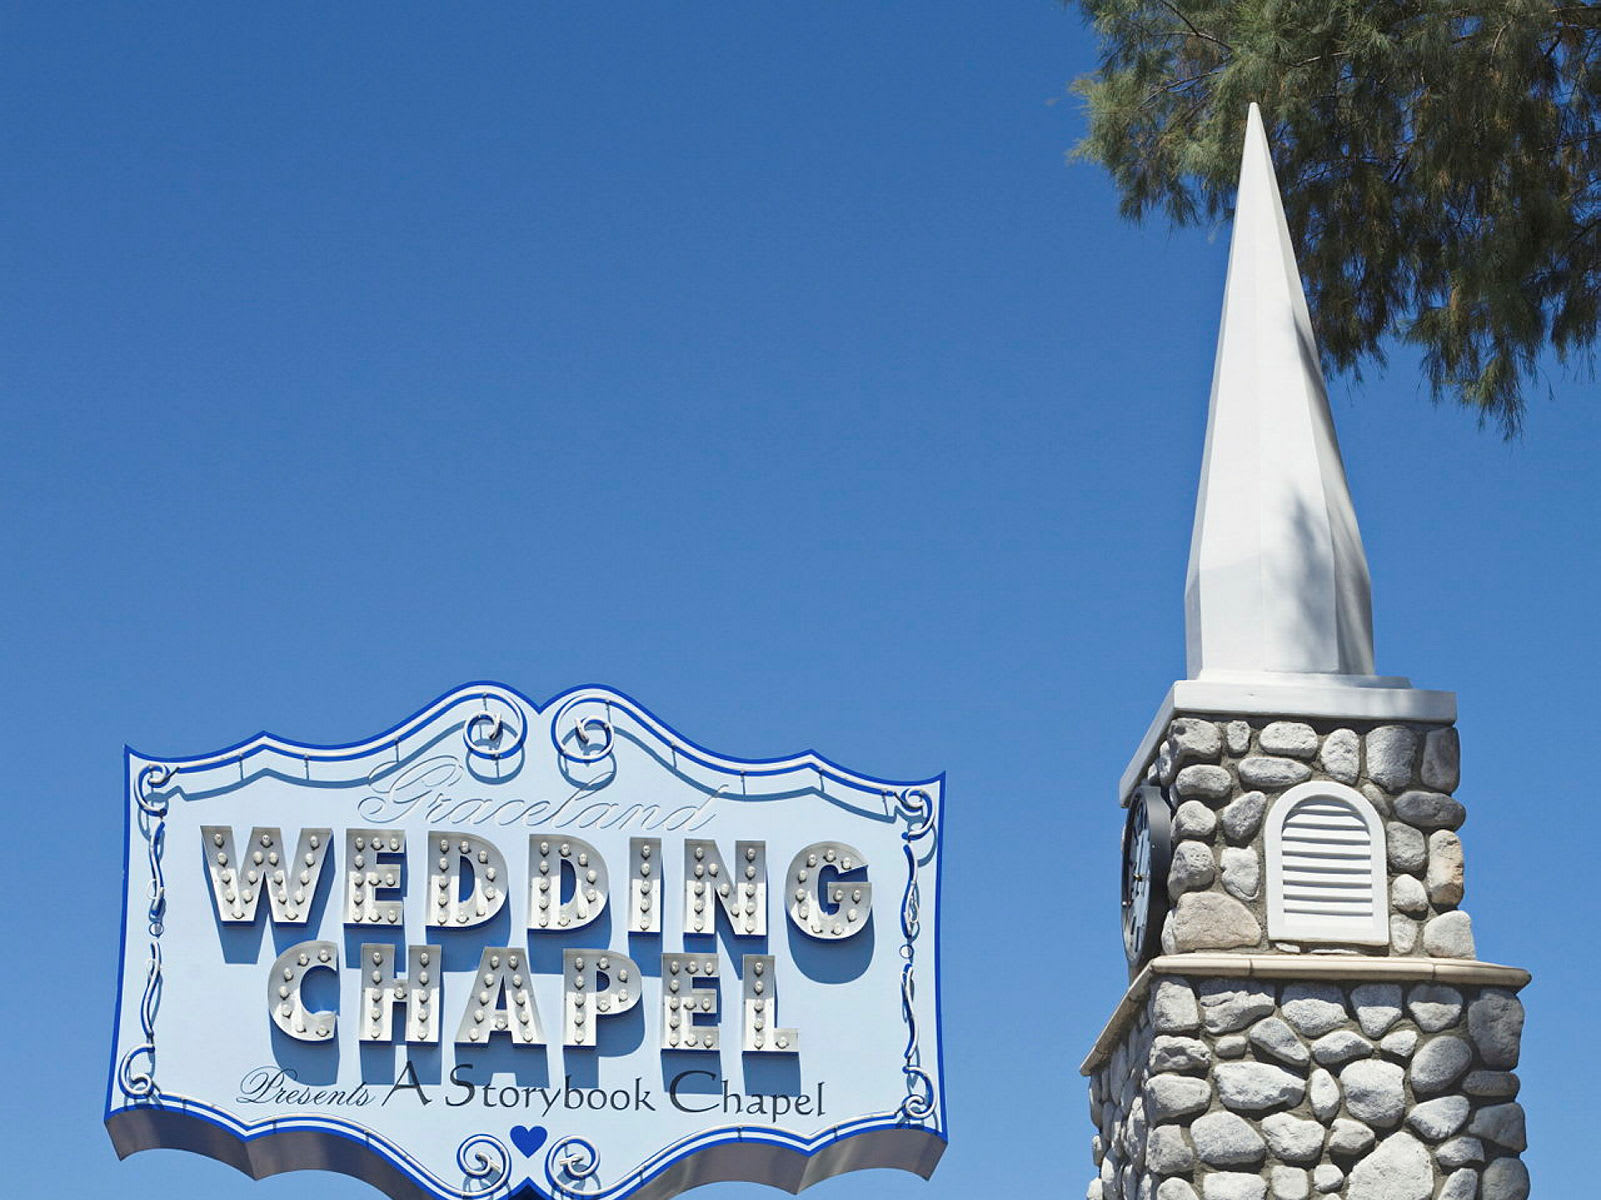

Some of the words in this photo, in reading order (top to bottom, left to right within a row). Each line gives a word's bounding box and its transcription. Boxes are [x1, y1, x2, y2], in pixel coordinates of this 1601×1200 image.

[357, 754, 730, 832] Graceland
[199, 825, 873, 941] WEDDING
[266, 940, 799, 1053] CHAPEL
[235, 1065, 376, 1107] Presents
[382, 1060, 432, 1107] A
[445, 1063, 656, 1118] Storybook
[669, 1070, 826, 1123] Chapel
